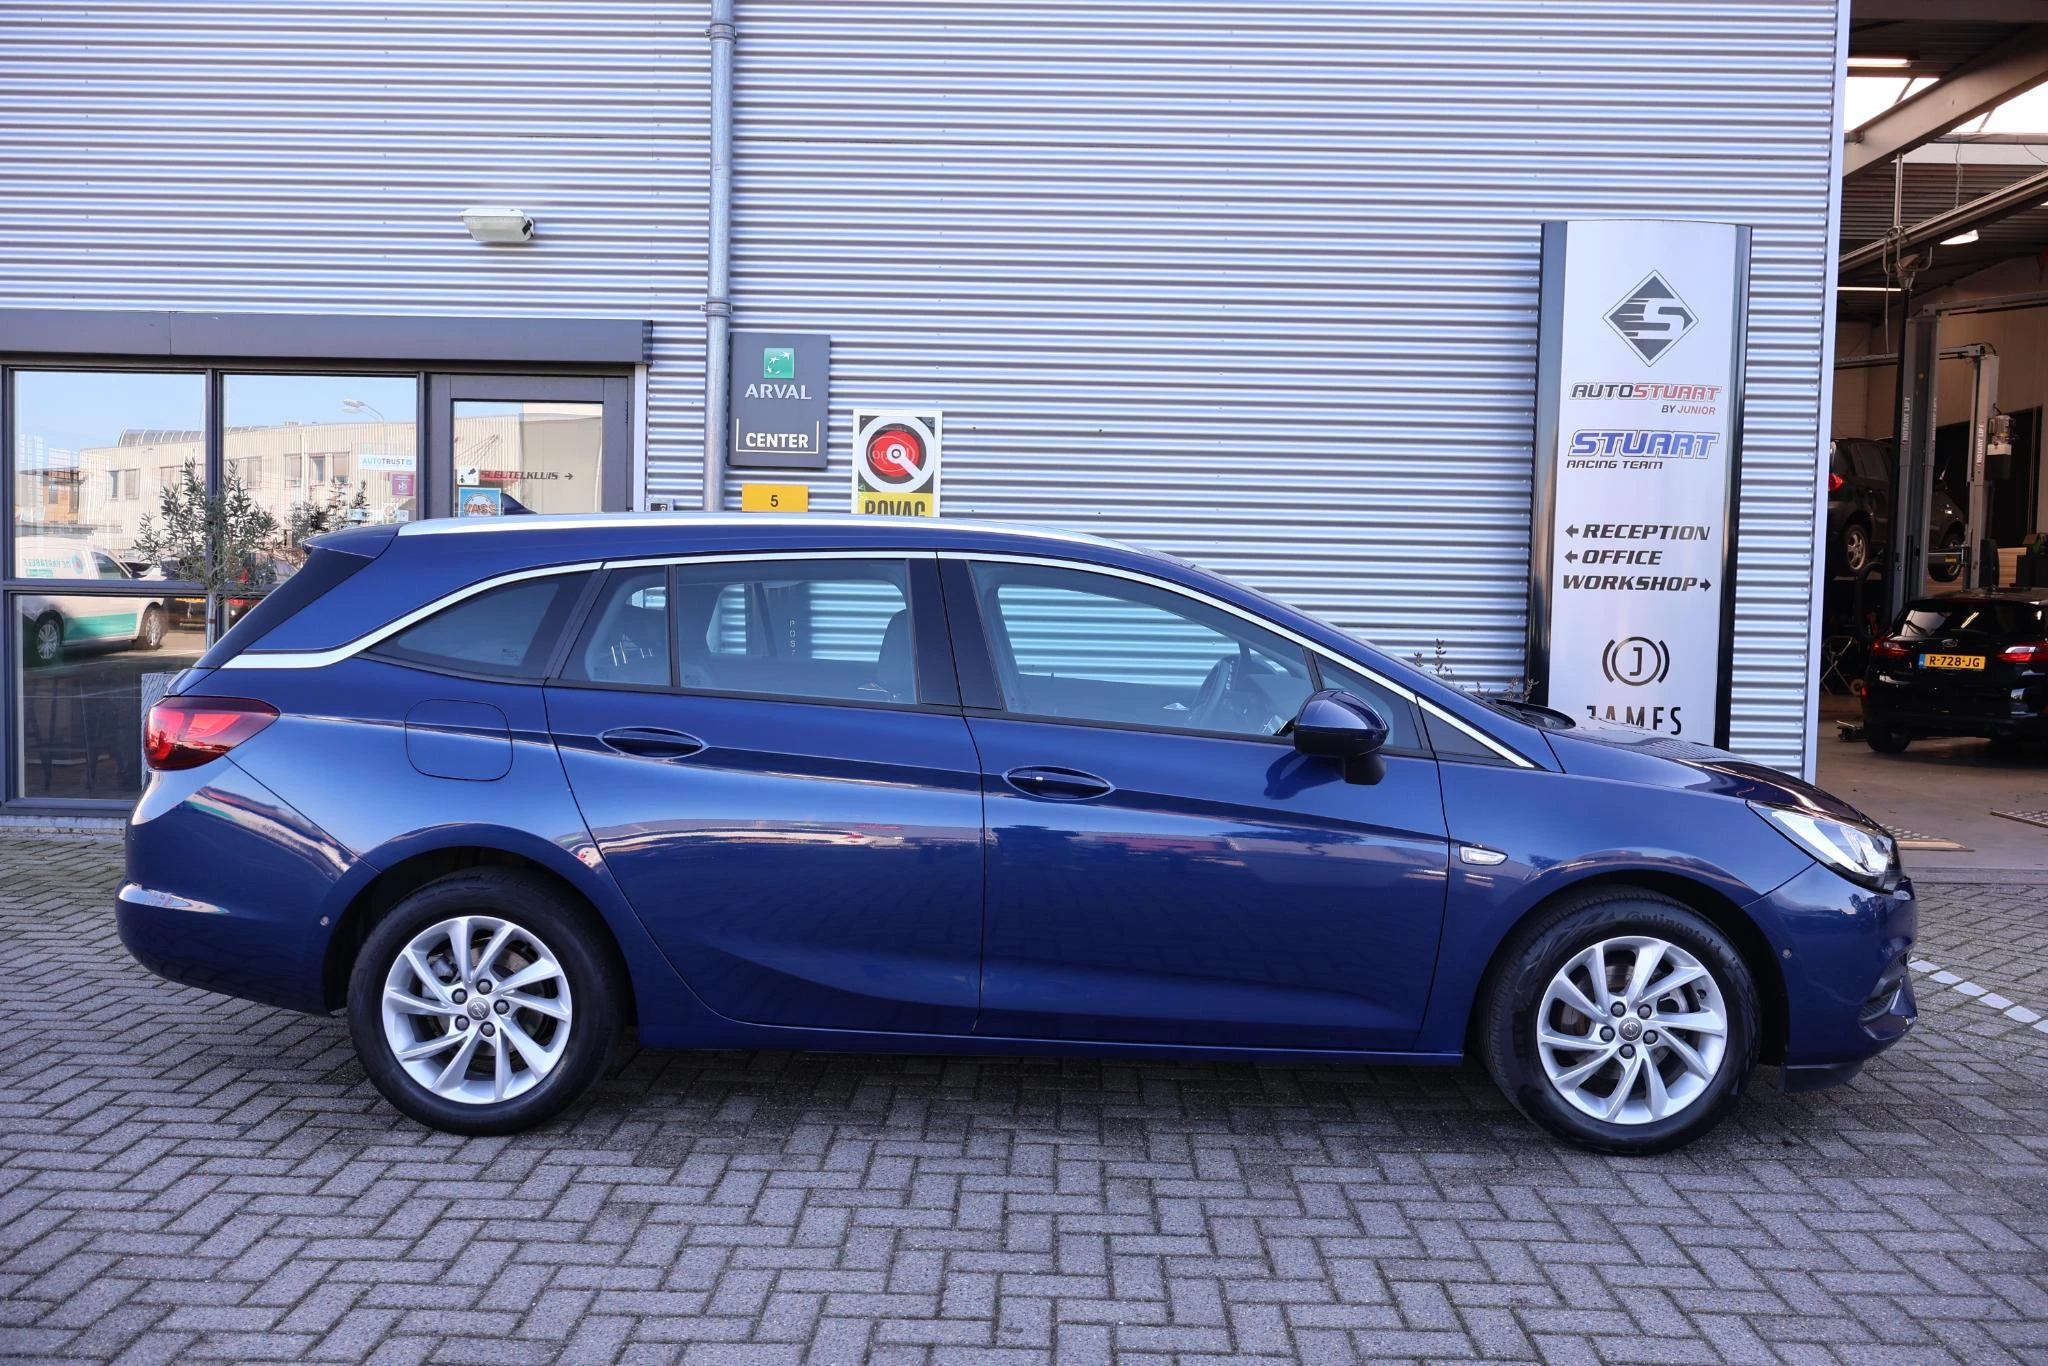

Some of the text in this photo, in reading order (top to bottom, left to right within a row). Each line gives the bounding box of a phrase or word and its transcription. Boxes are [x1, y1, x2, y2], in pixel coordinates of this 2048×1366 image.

[745, 383, 812, 400] ARVAL
[1571, 383, 1720, 401] AUTOSTUART
[1661, 404, 1716, 415] BY JUNIOR
[745, 432, 809, 448] CENTER
[1570, 431, 1718, 457] STUART
[362, 457, 405, 465] AUTOTRUST
[1566, 460, 1663, 469] RACING TEAM
[770, 494, 779, 507] 5
[1582, 524, 1710, 541] RECEPTION
[1582, 549, 1663, 565] OFFICE
[1563, 575, 1698, 591] WORKSHOP
[1929, 655, 1981, 668] R-728-JG
